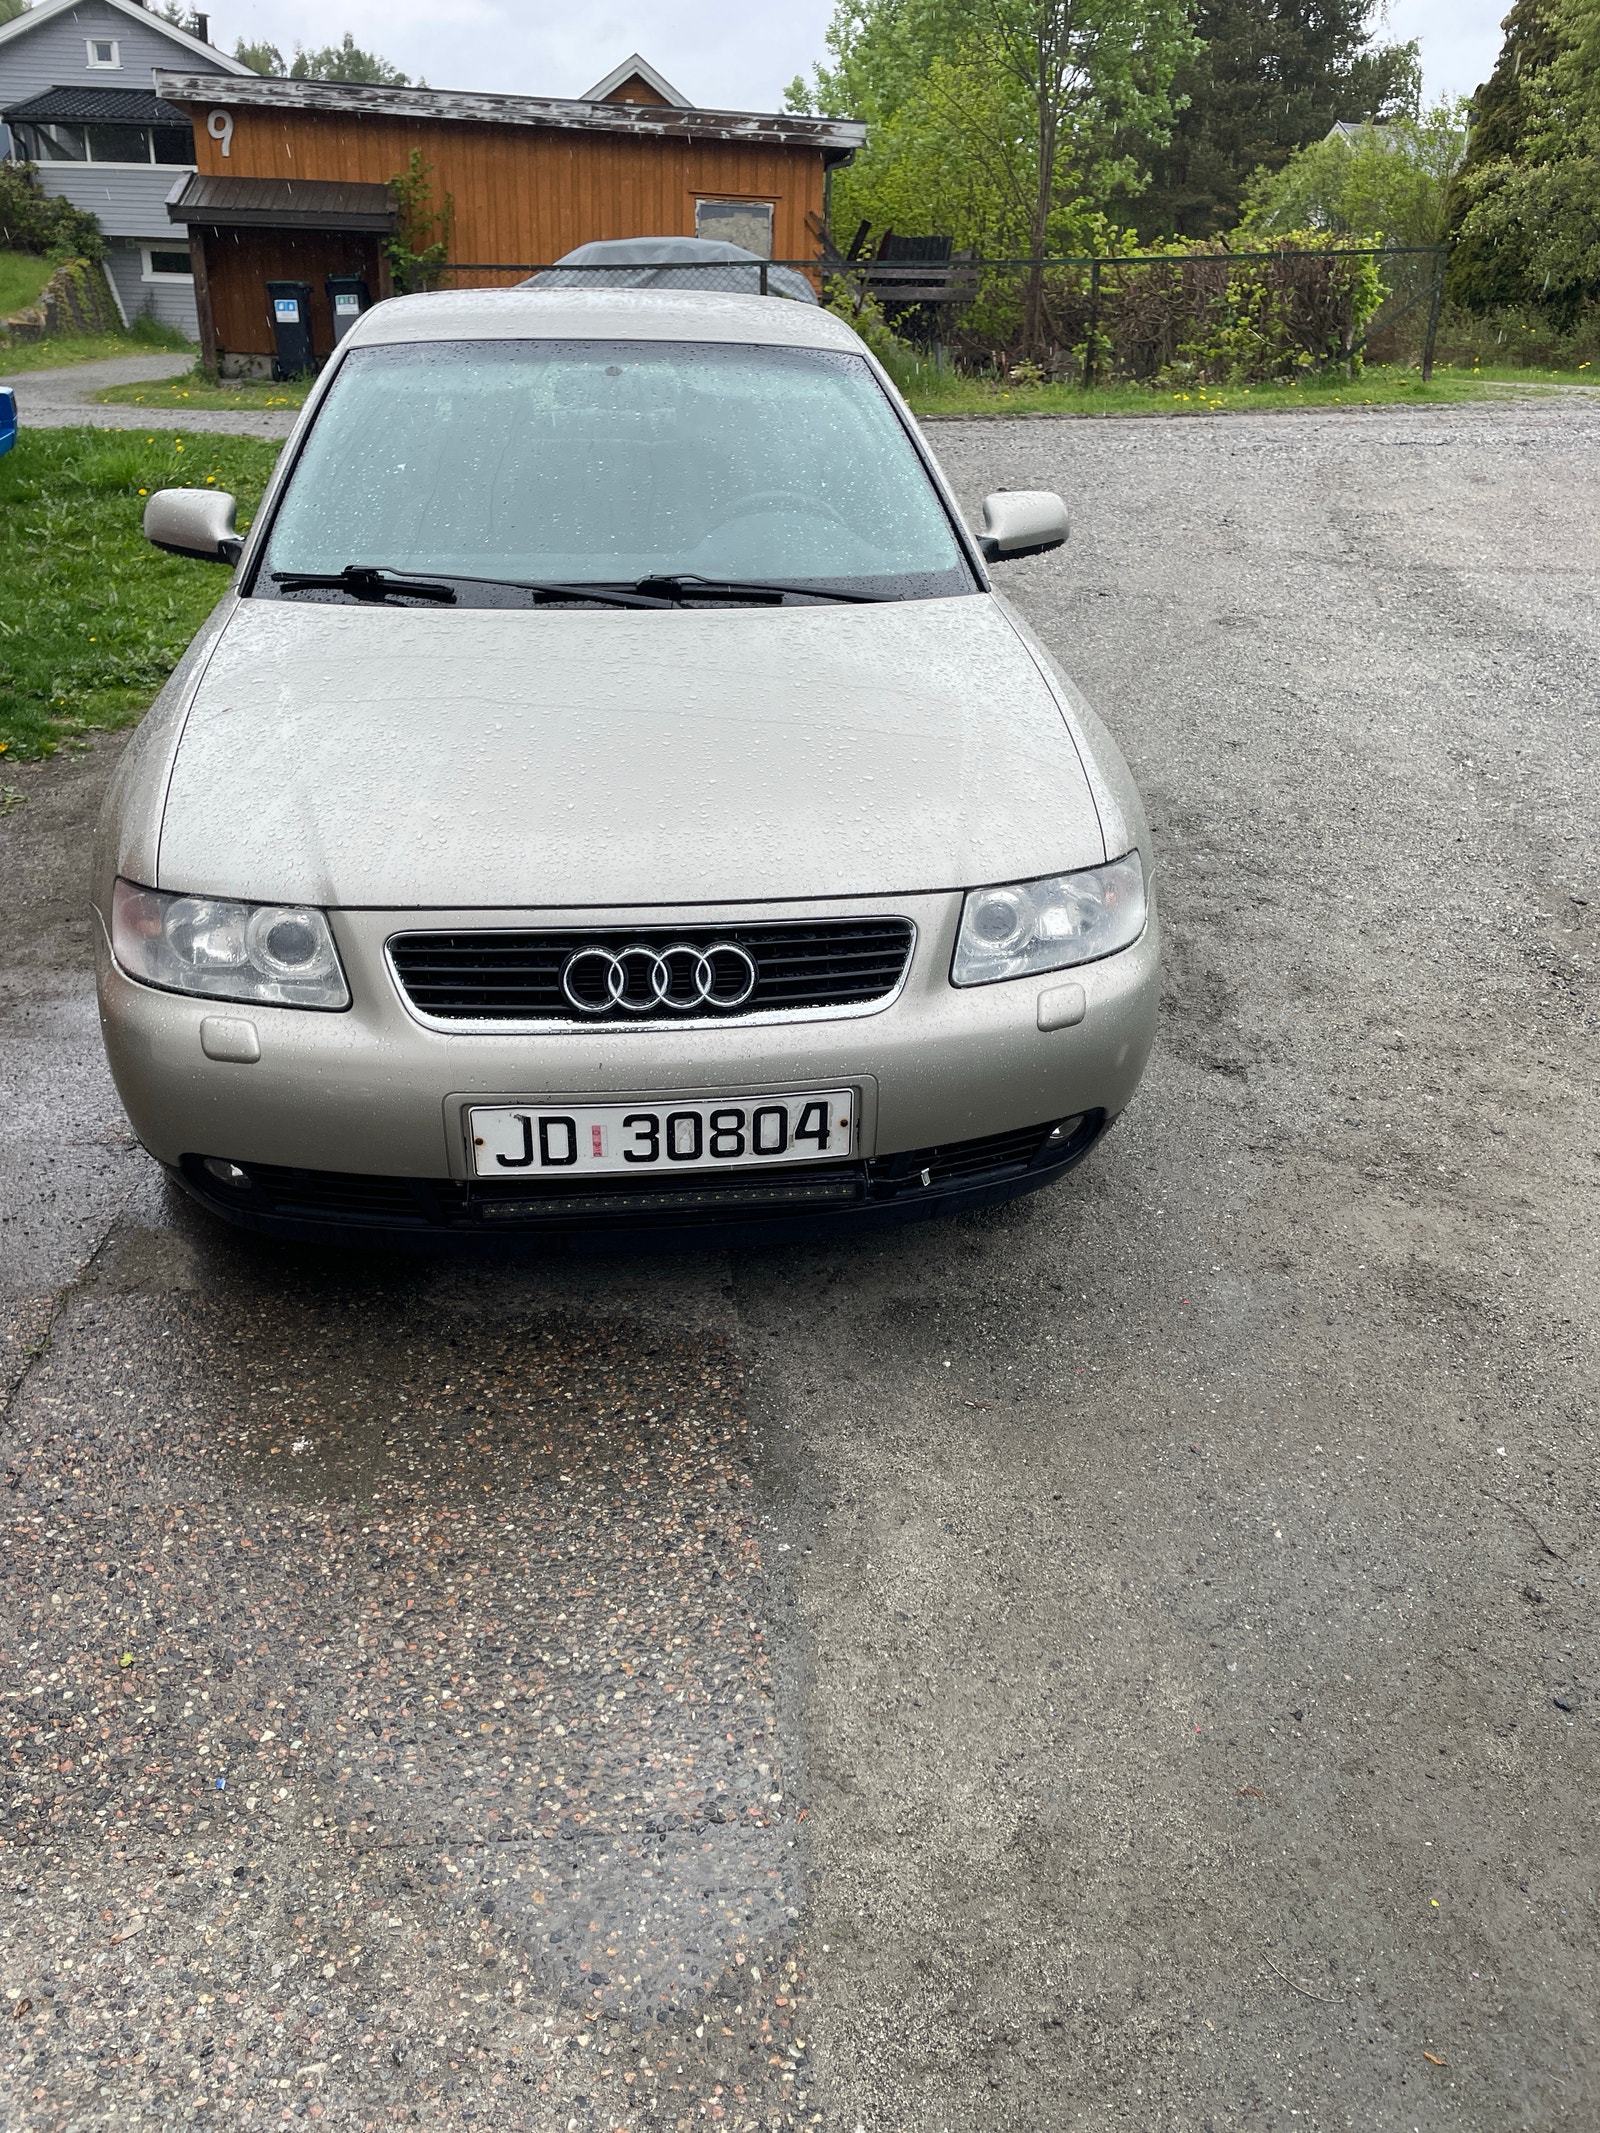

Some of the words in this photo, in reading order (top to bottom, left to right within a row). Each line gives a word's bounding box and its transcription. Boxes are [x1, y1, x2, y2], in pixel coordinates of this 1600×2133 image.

[207, 109, 234, 157] 9
[496, 1115, 577, 1167] JD
[622, 1101, 831, 1163] 30804
